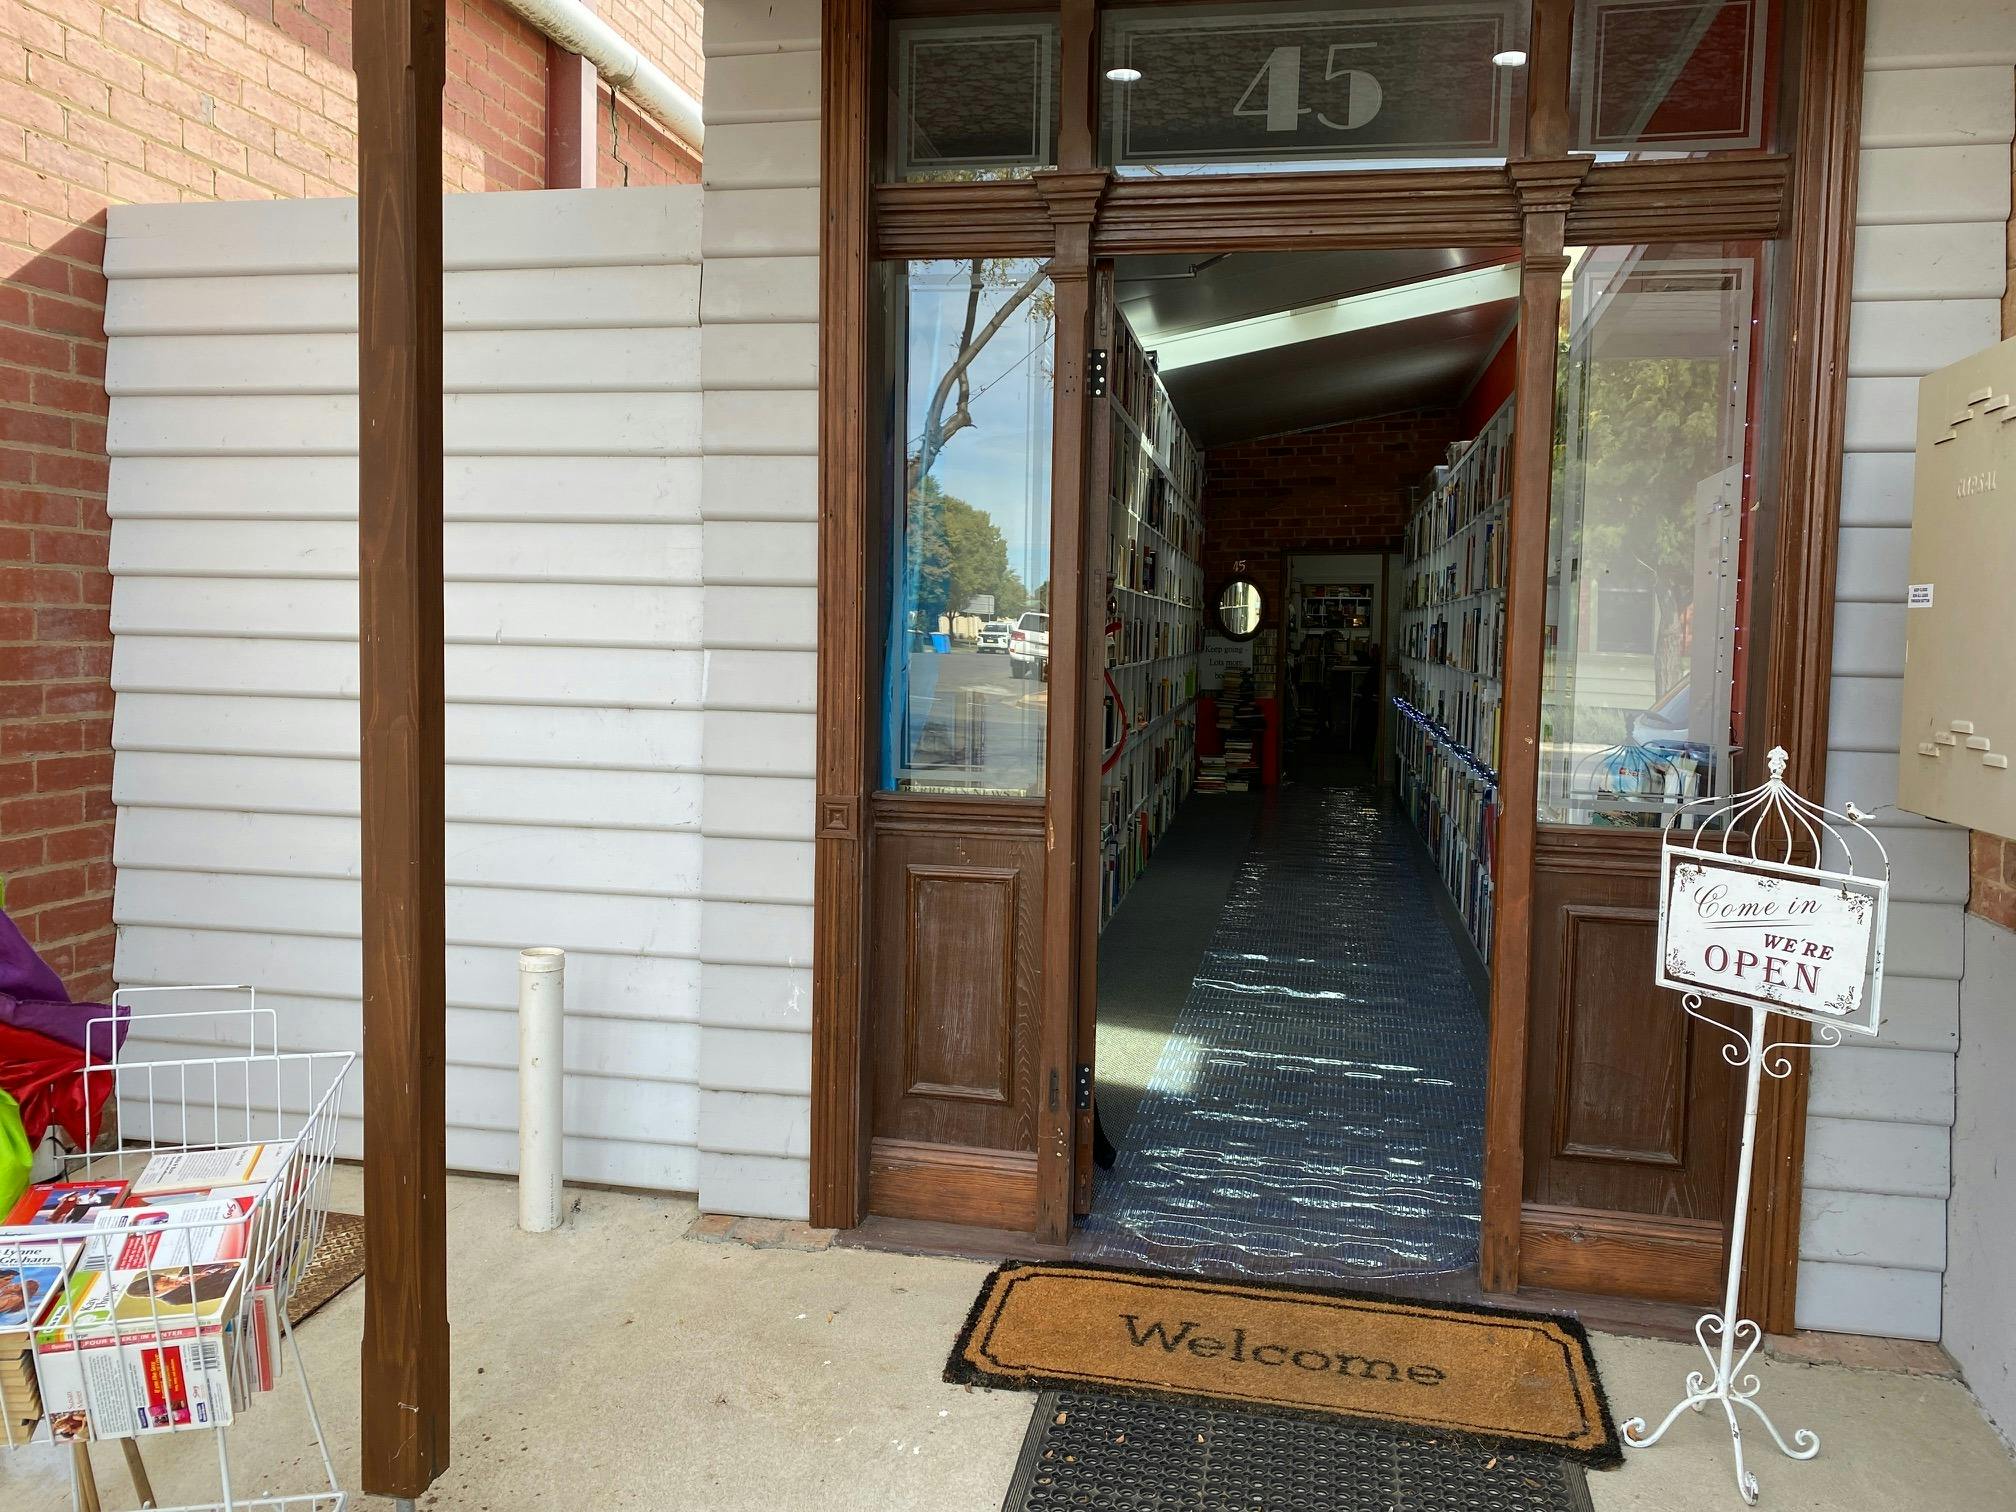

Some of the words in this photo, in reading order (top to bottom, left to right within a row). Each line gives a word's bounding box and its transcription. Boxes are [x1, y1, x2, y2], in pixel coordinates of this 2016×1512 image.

[1232, 42, 1384, 132] 45
[1205, 644, 1224, 654] Keep
[1224, 646, 1243, 655] going
[1693, 884, 1781, 919] Come
[1788, 897, 1822, 915] in
[1764, 933, 1834, 961] WE'RE
[1704, 944, 1822, 994] OPEN
[1118, 1313, 1448, 1386] Welcome
